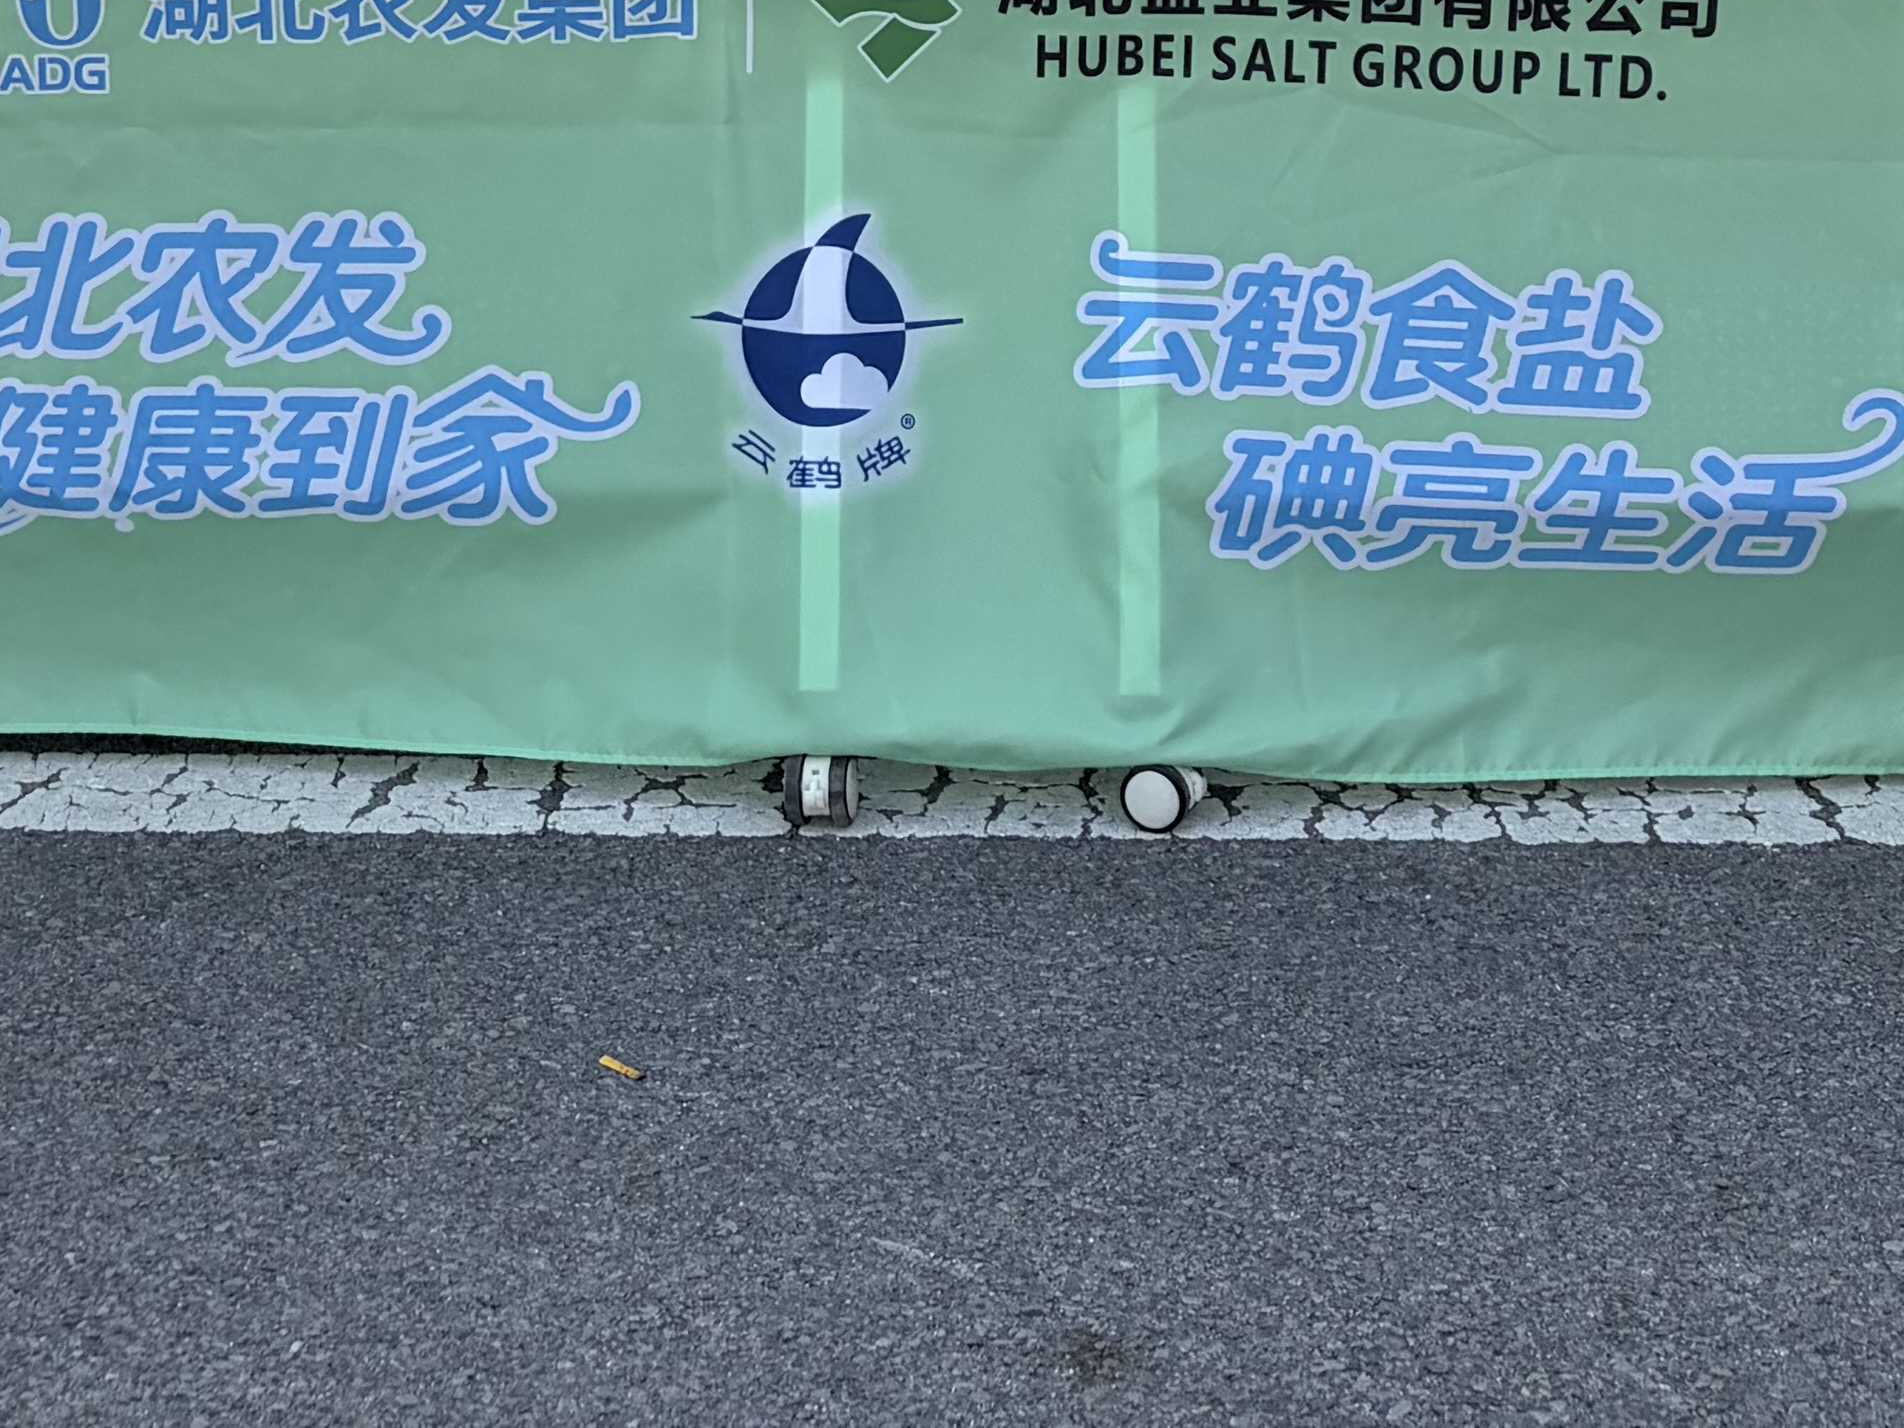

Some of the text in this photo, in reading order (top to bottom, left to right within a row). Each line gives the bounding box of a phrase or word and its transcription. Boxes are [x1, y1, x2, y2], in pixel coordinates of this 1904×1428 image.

[1036, 33, 1668, 102] HUBEI SALT GROUP LTD.
[1072, 229, 1667, 420] 云鹤食盐
[732, 426, 914, 493] 云鹤牌
